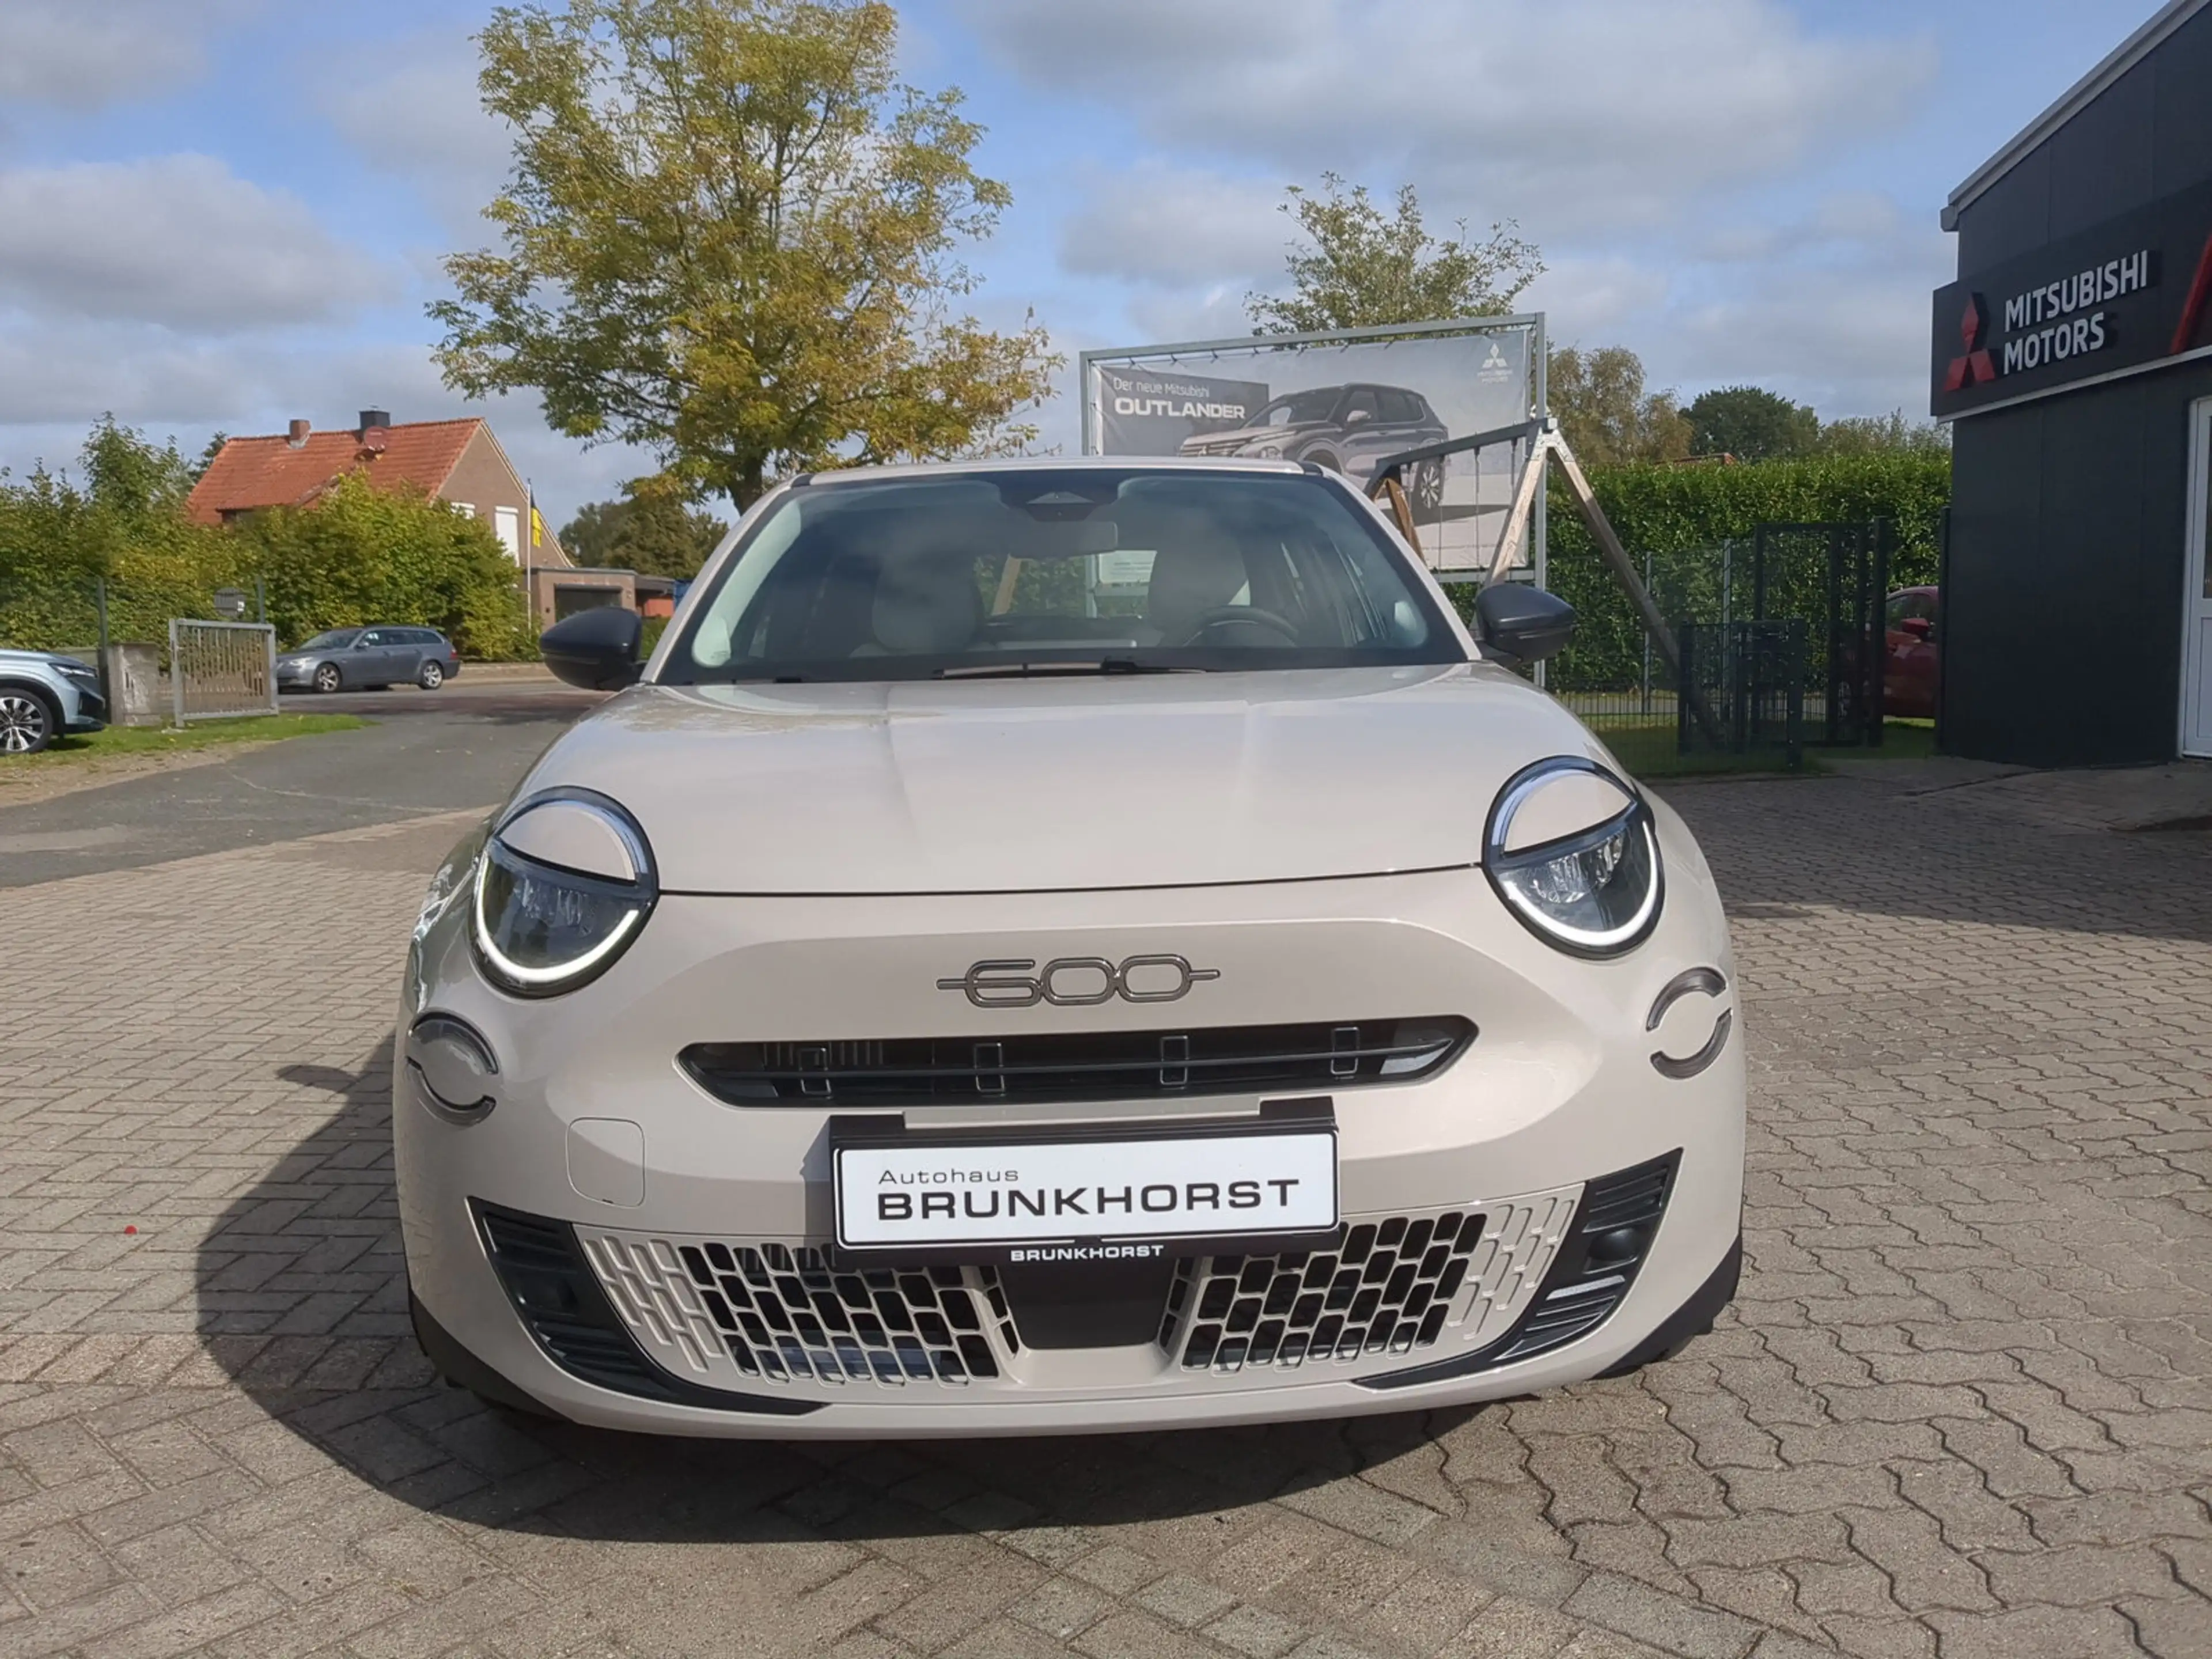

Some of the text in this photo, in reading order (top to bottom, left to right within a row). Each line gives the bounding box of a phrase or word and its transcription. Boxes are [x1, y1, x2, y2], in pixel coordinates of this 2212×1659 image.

[2004, 249, 2147, 332] MITSUBISHI
[2003, 312, 2105, 376] MOTORS
[1113, 377, 1210, 397] Der neue Mitsubishi
[1115, 397, 1245, 419] OUTLANDER
[964, 954, 1194, 1009] 600
[878, 1168, 1019, 1184] Autohaus
[878, 1179, 1300, 1221] BRUNKHORST
[1010, 1244, 1164, 1262] BRUNKHORST
